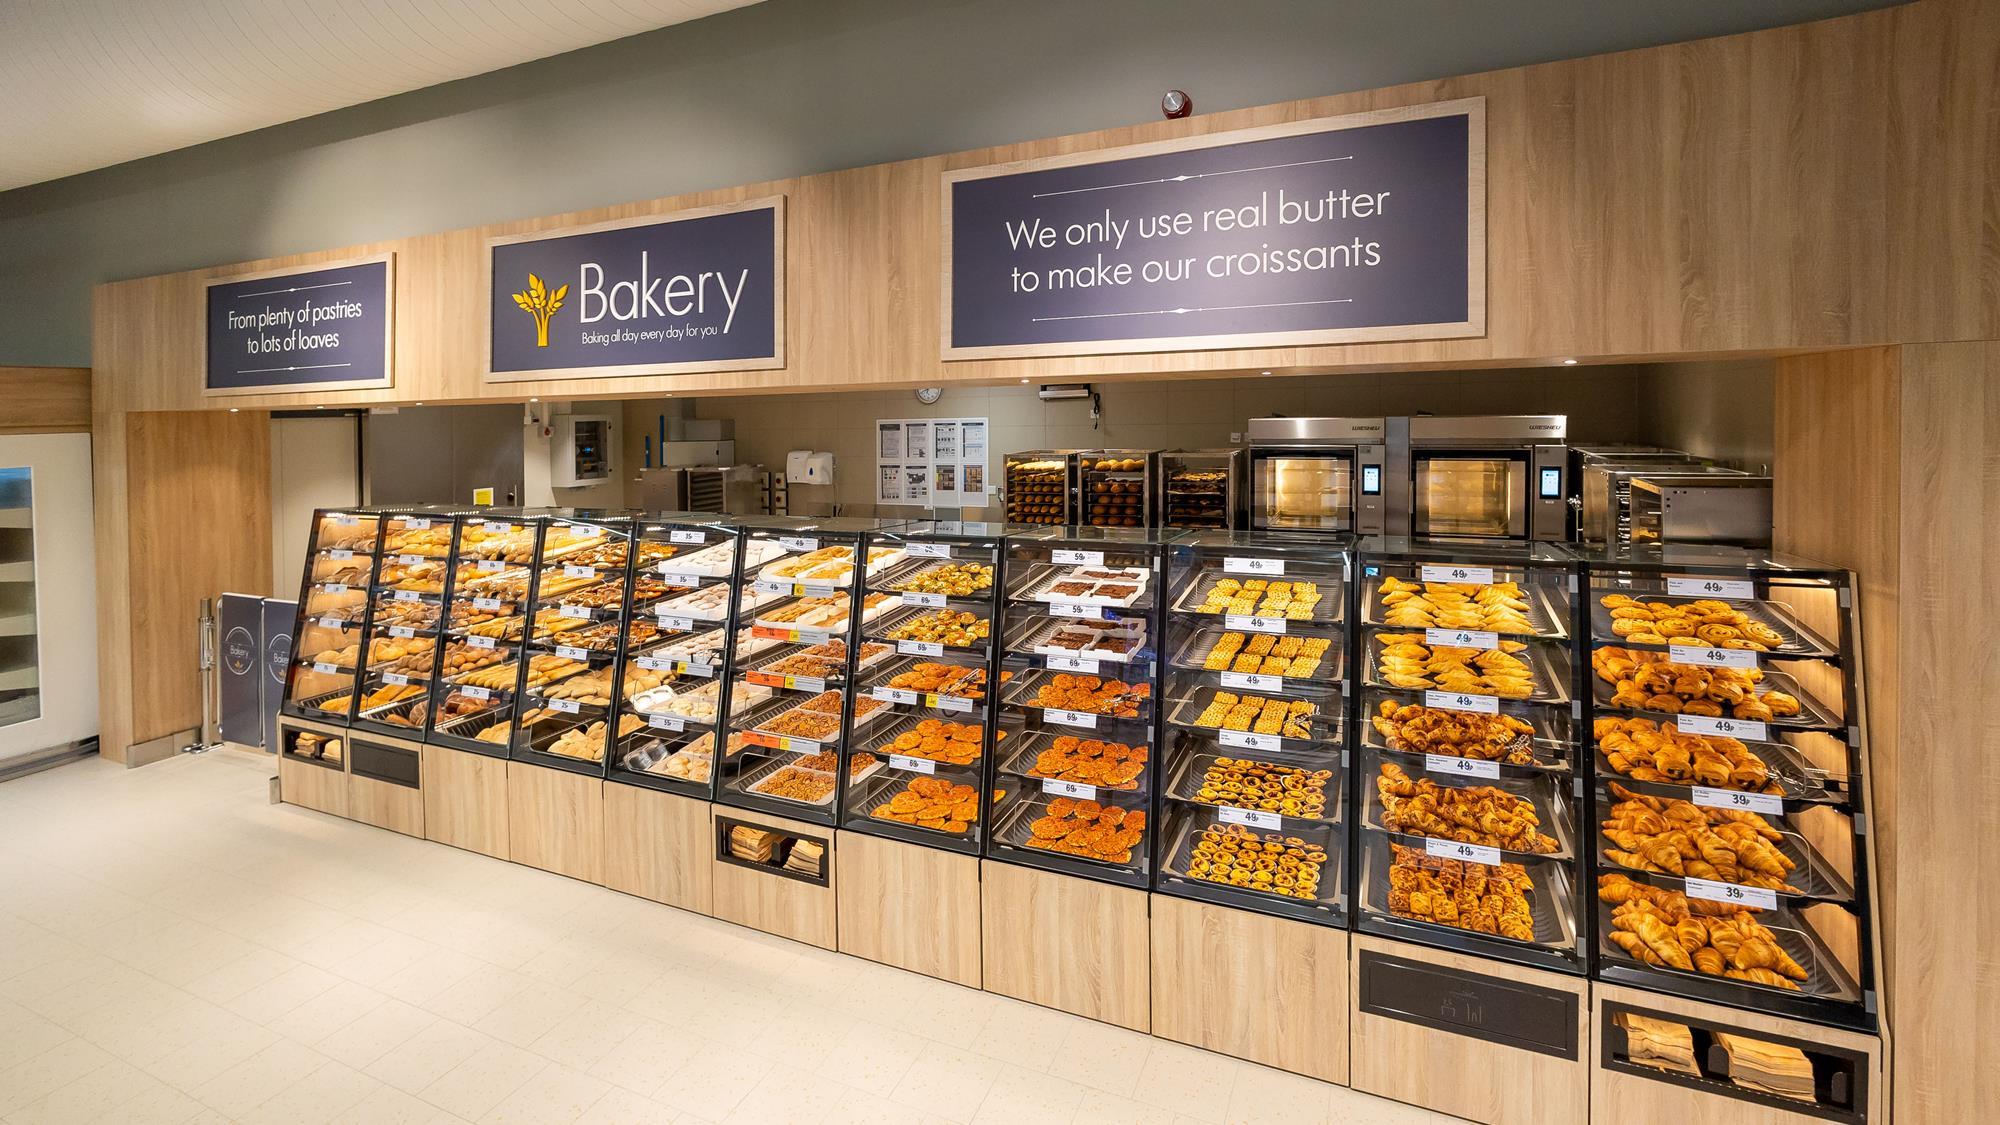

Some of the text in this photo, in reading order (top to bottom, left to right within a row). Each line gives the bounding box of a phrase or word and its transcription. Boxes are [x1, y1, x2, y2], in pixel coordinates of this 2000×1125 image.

[1005, 188, 1391, 251] We only use real butter
[1011, 236, 1382, 293] to make our croissants
[579, 250, 749, 334] Bakery
[228, 299, 363, 332] From plenty of pastries
[581, 322, 718, 347] Baking all day every day for you
[247, 329, 340, 354] to lots of loaves
[1451, 569, 1468, 579] 49p
[1704, 582, 1723, 592] 49p
[273, 652, 289, 664] Bake
[1706, 650, 1726, 662] 49p
[1456, 695, 1473, 707] 49p
[1715, 720, 1735, 733] 49p
[1457, 760, 1474, 771] 49p
[1732, 793, 1751, 806] 39p
[1457, 845, 1474, 857] 49p
[1726, 886, 1745, 900] 39p
